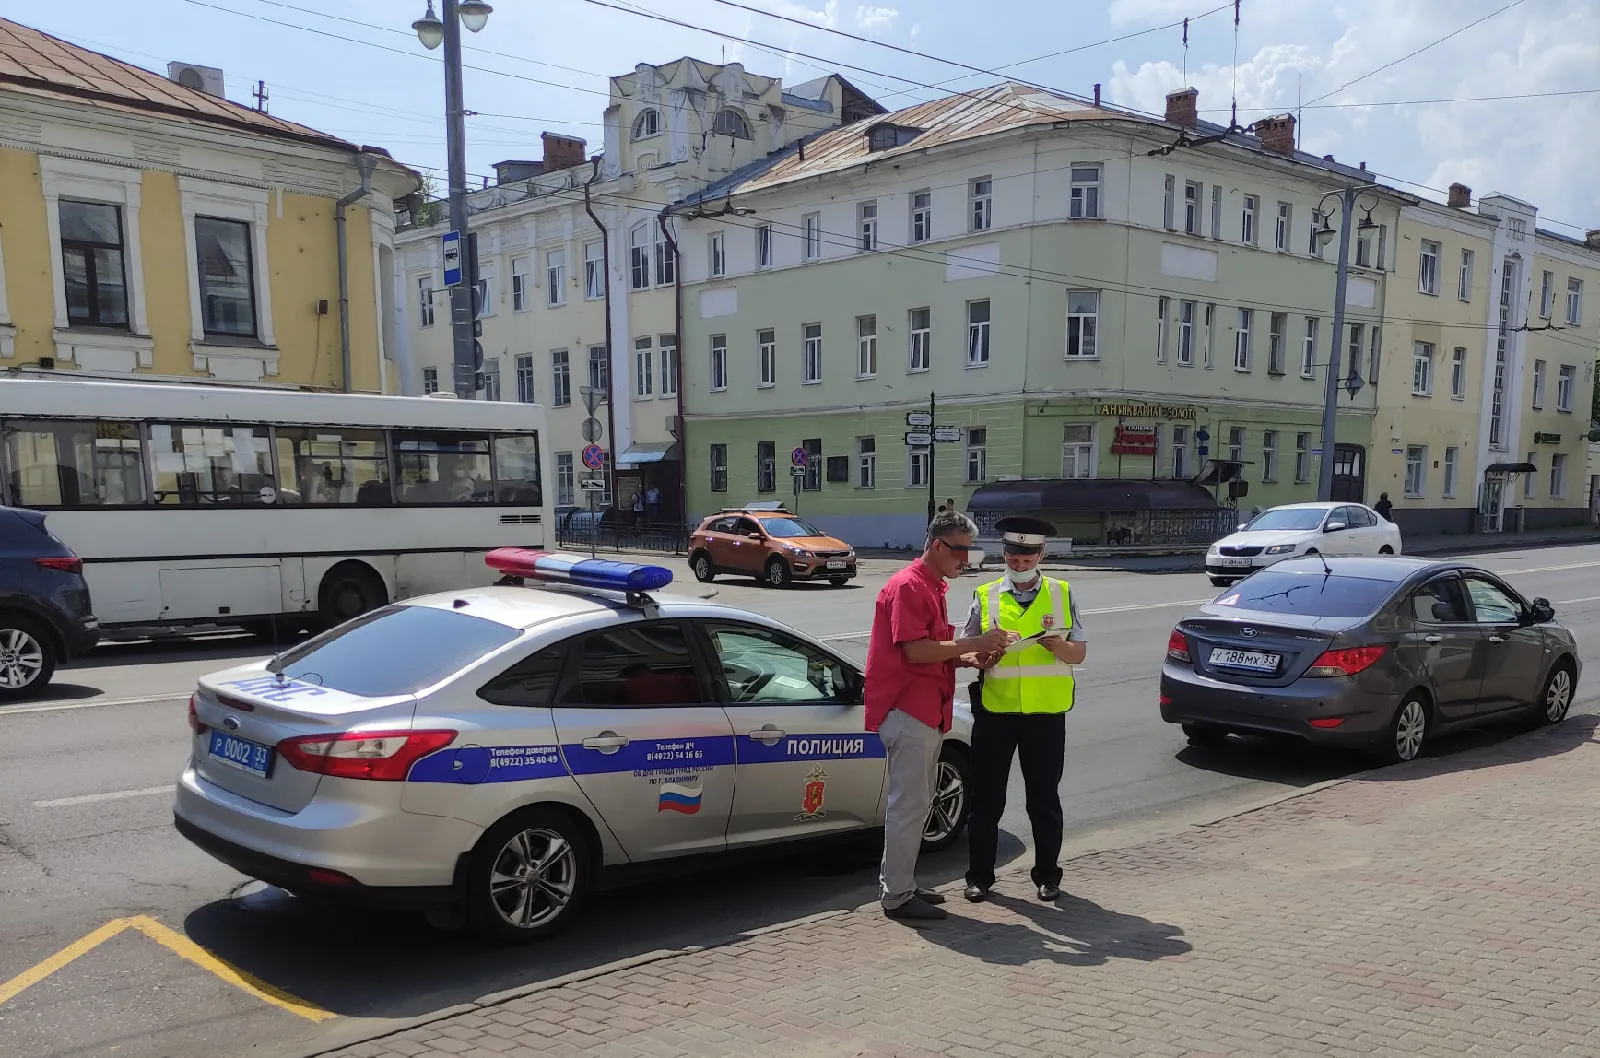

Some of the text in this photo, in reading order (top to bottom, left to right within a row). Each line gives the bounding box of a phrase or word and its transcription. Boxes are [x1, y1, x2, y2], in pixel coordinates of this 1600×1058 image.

[1264, 655, 1276, 665] 33
[491, 746, 557, 757] Телефон доверия
[656, 742, 695, 752] Телефон ДЧ
[787, 739, 864, 757] ПОЛИЦИЯ
[255, 746, 267, 764] 33
[647, 752, 674, 761] 8(4922)
[675, 751, 684, 760] 54
[685, 751, 693, 759] 16
[490, 755, 558, 767] 8(4922) 35 40 49
